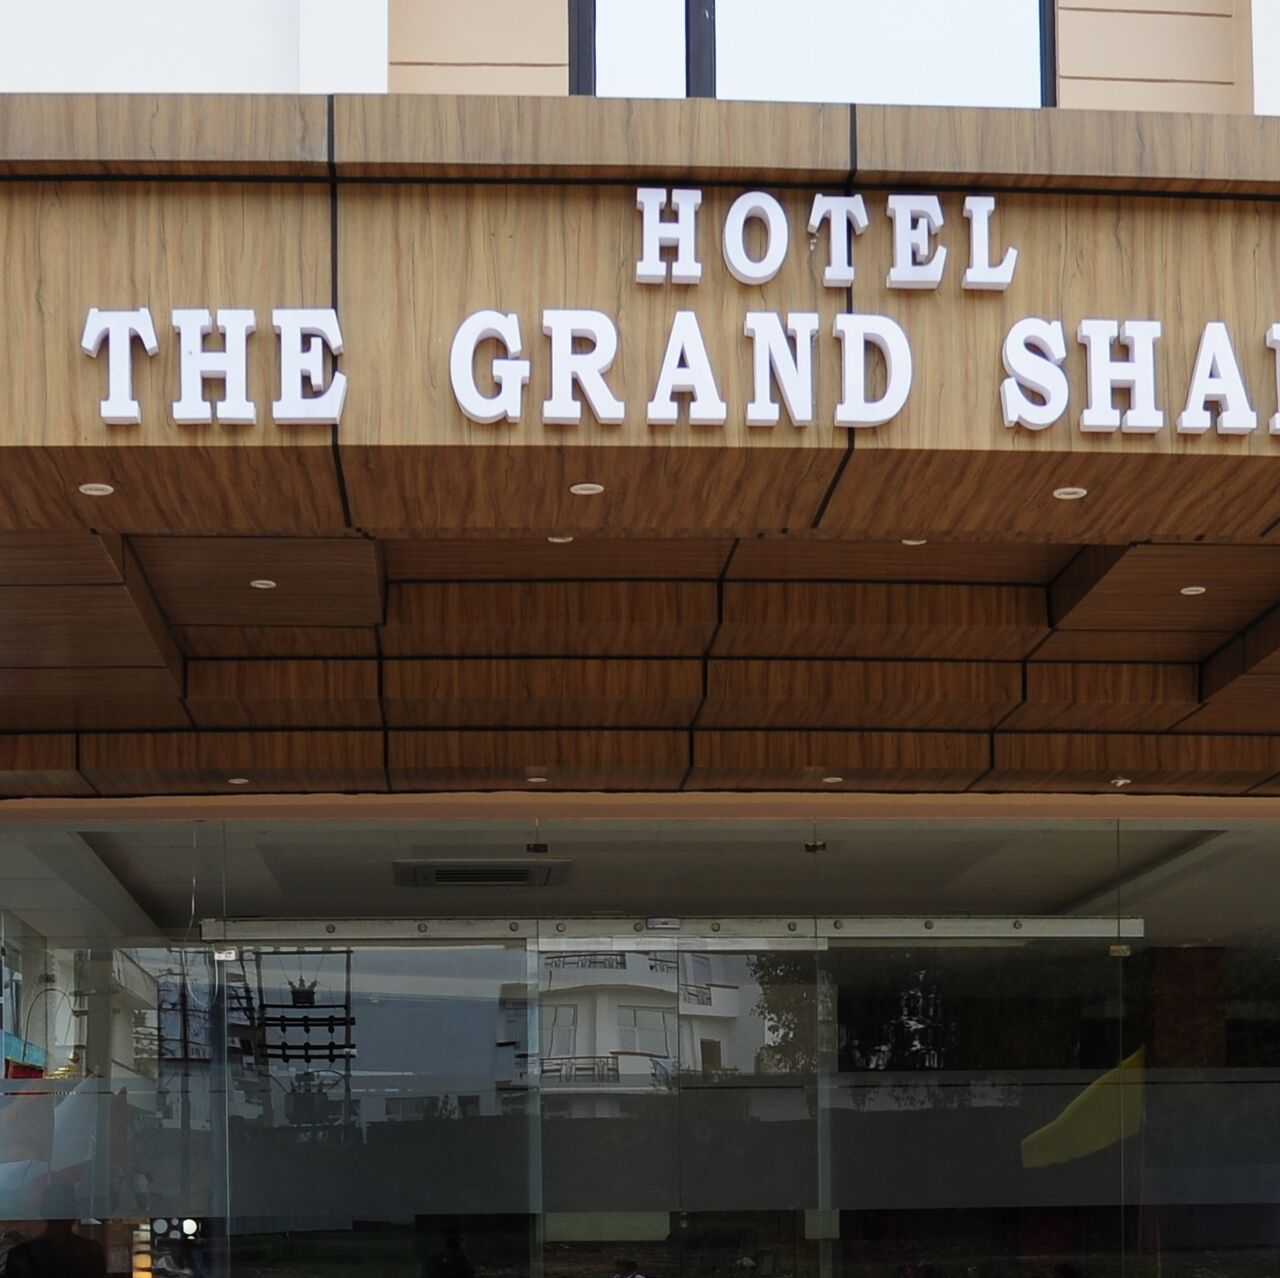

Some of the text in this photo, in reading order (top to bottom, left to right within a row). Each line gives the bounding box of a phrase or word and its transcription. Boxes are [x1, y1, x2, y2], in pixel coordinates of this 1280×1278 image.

[636, 188, 1017, 291] HOTEL
[81, 308, 347, 425] THE
[450, 310, 912, 428] GRAND
